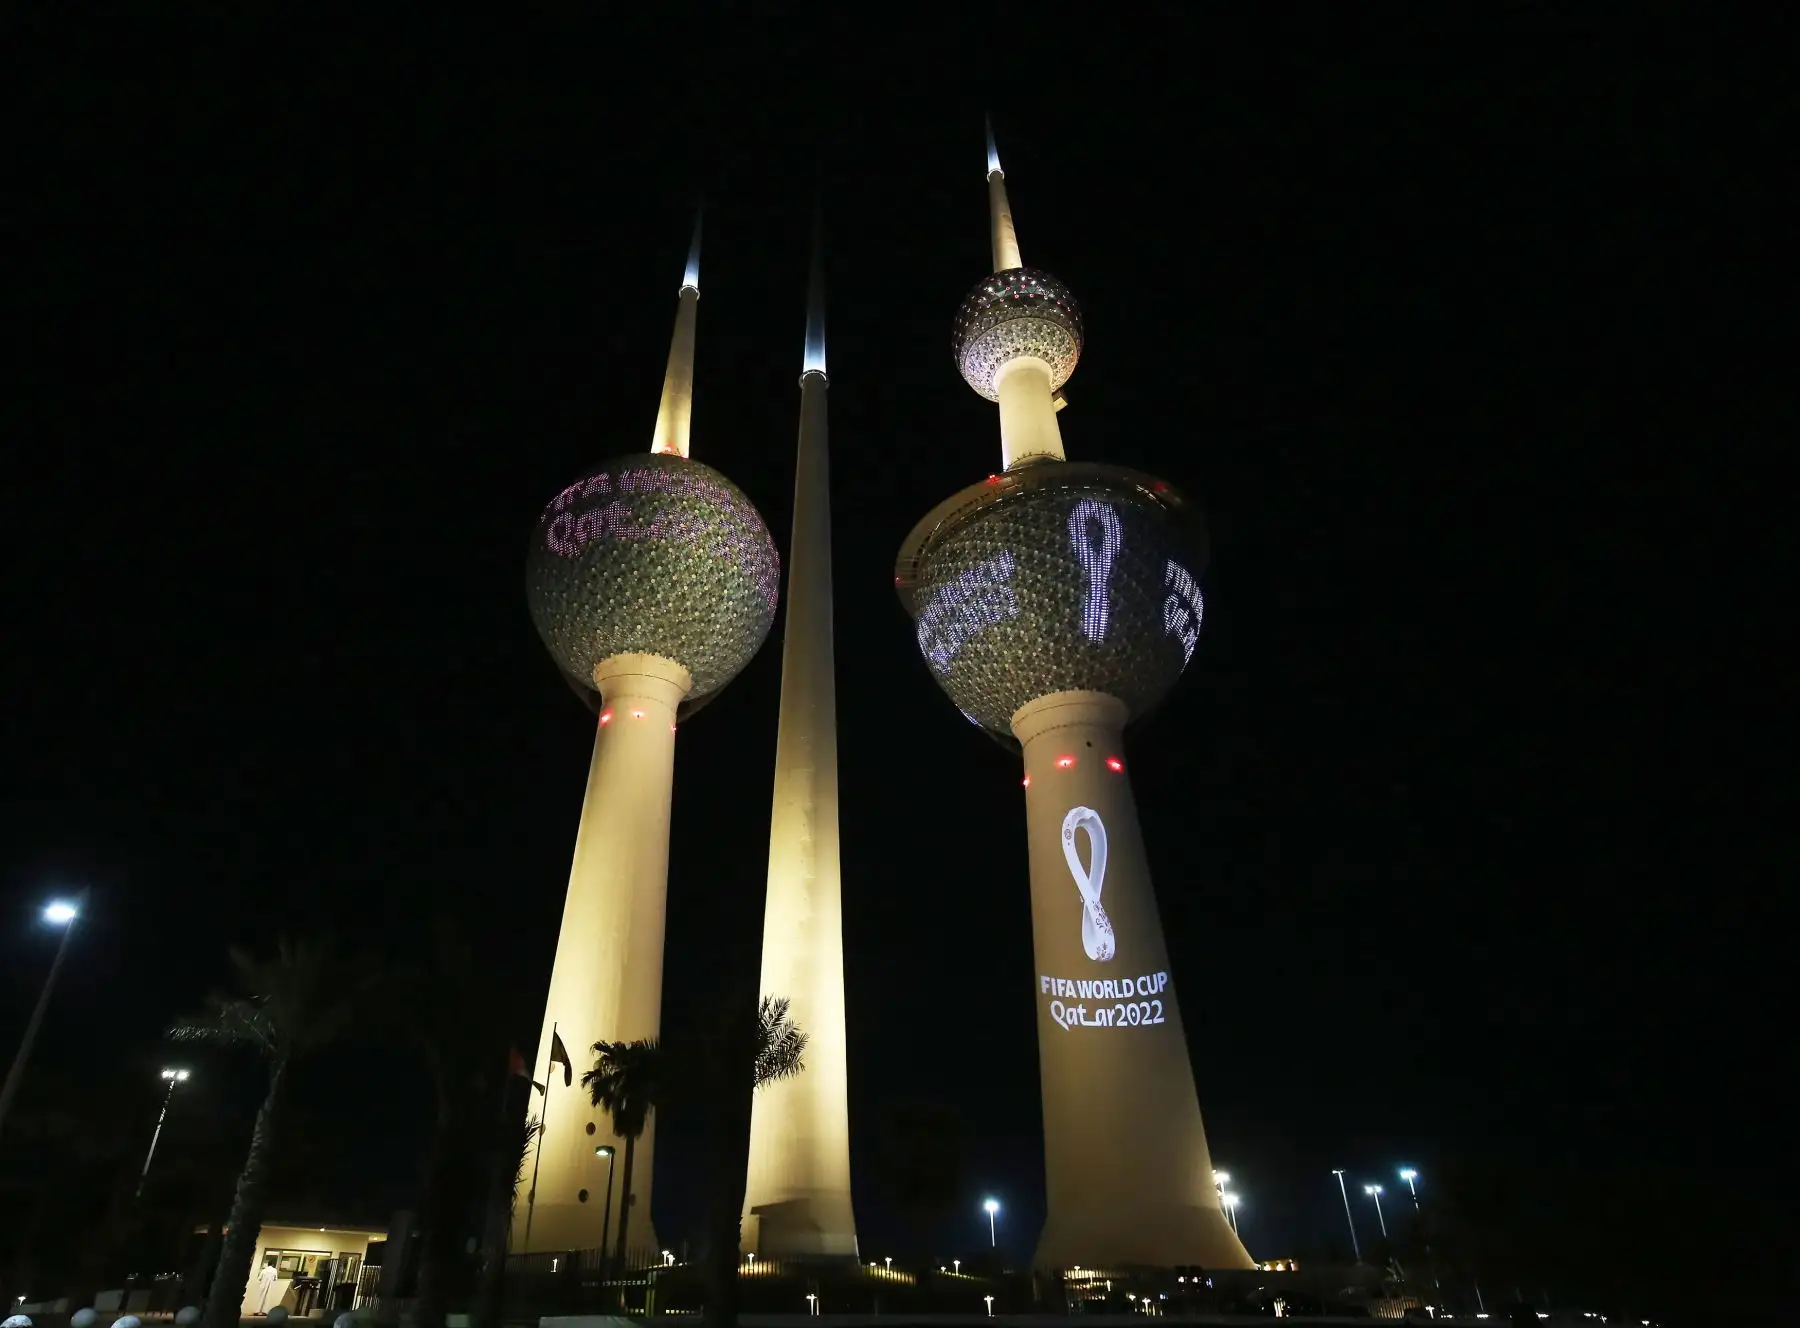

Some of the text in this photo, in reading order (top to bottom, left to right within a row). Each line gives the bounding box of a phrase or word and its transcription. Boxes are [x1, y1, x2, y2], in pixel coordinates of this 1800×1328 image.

[1040, 971, 1168, 999] FIFA WORLD CUP
